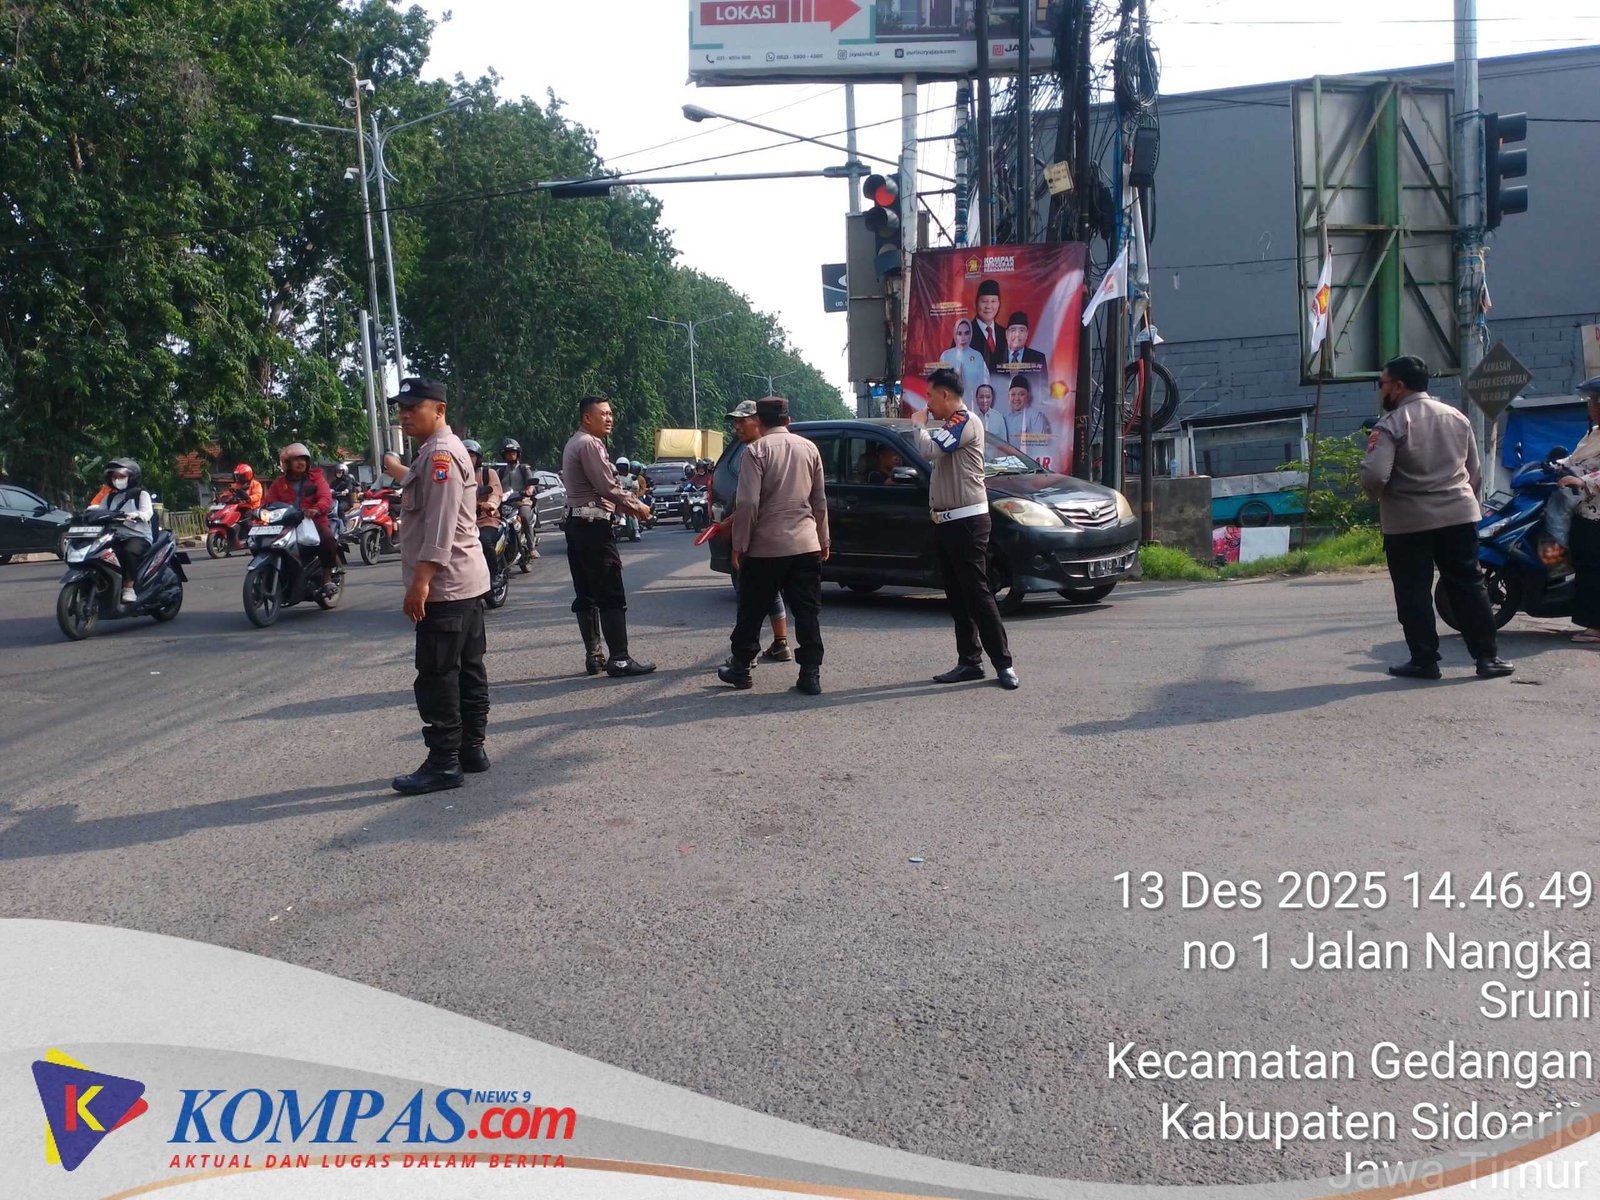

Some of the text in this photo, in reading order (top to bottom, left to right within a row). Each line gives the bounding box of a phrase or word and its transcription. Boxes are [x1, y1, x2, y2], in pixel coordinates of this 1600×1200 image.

[716, 5, 776, 21] LOKASI
[1483, 360, 1512, 372] KAWASAN
[1492, 374, 1528, 387] KECEPATAN
